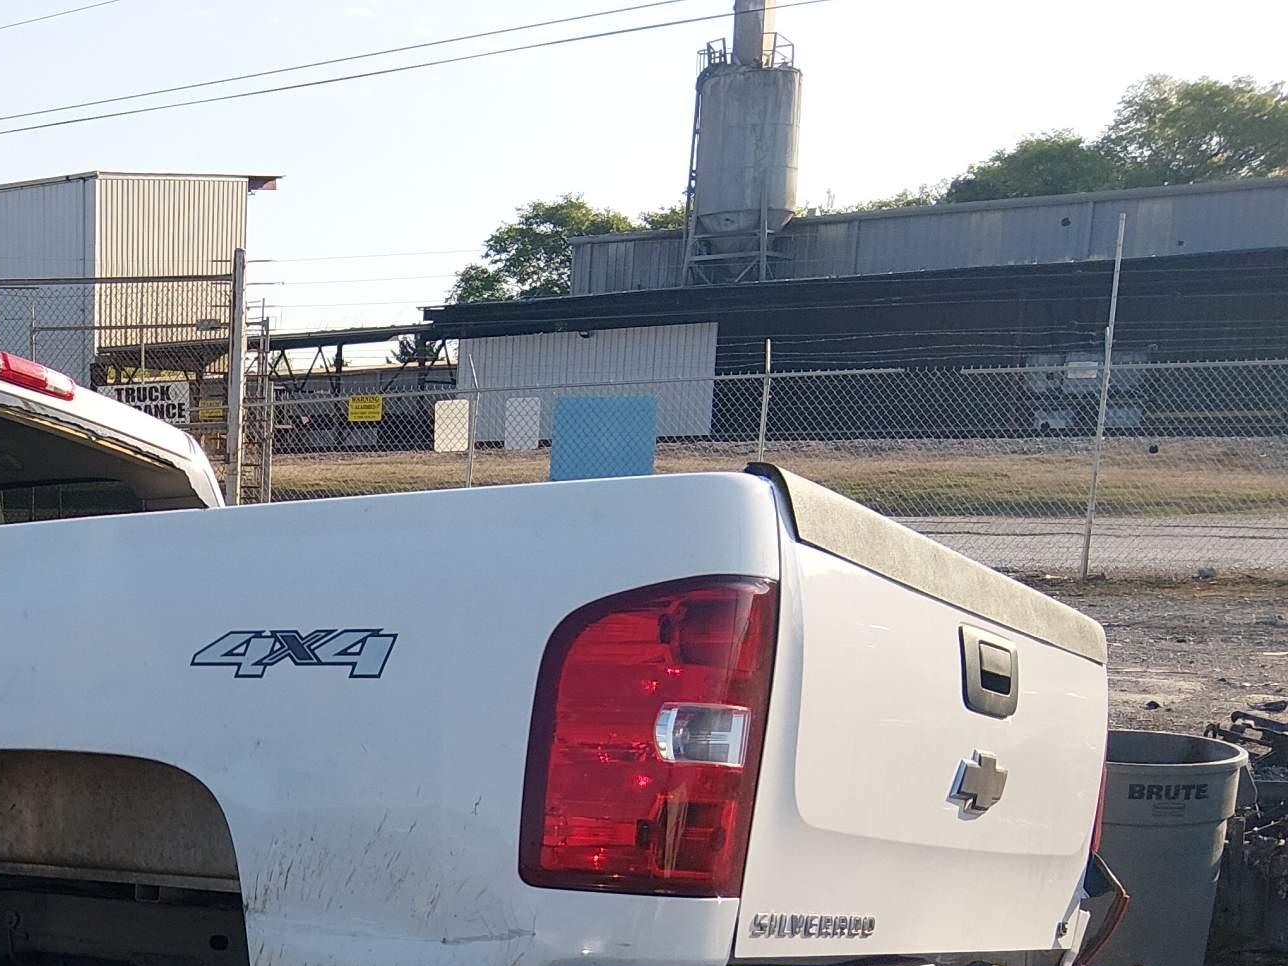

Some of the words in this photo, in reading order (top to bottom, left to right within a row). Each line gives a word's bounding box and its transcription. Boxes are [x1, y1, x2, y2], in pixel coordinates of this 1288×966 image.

[114, 386, 172, 402] TRUCK
[1128, 783, 1209, 800] BRUTE
[749, 912, 876, 938] SILVERADO
